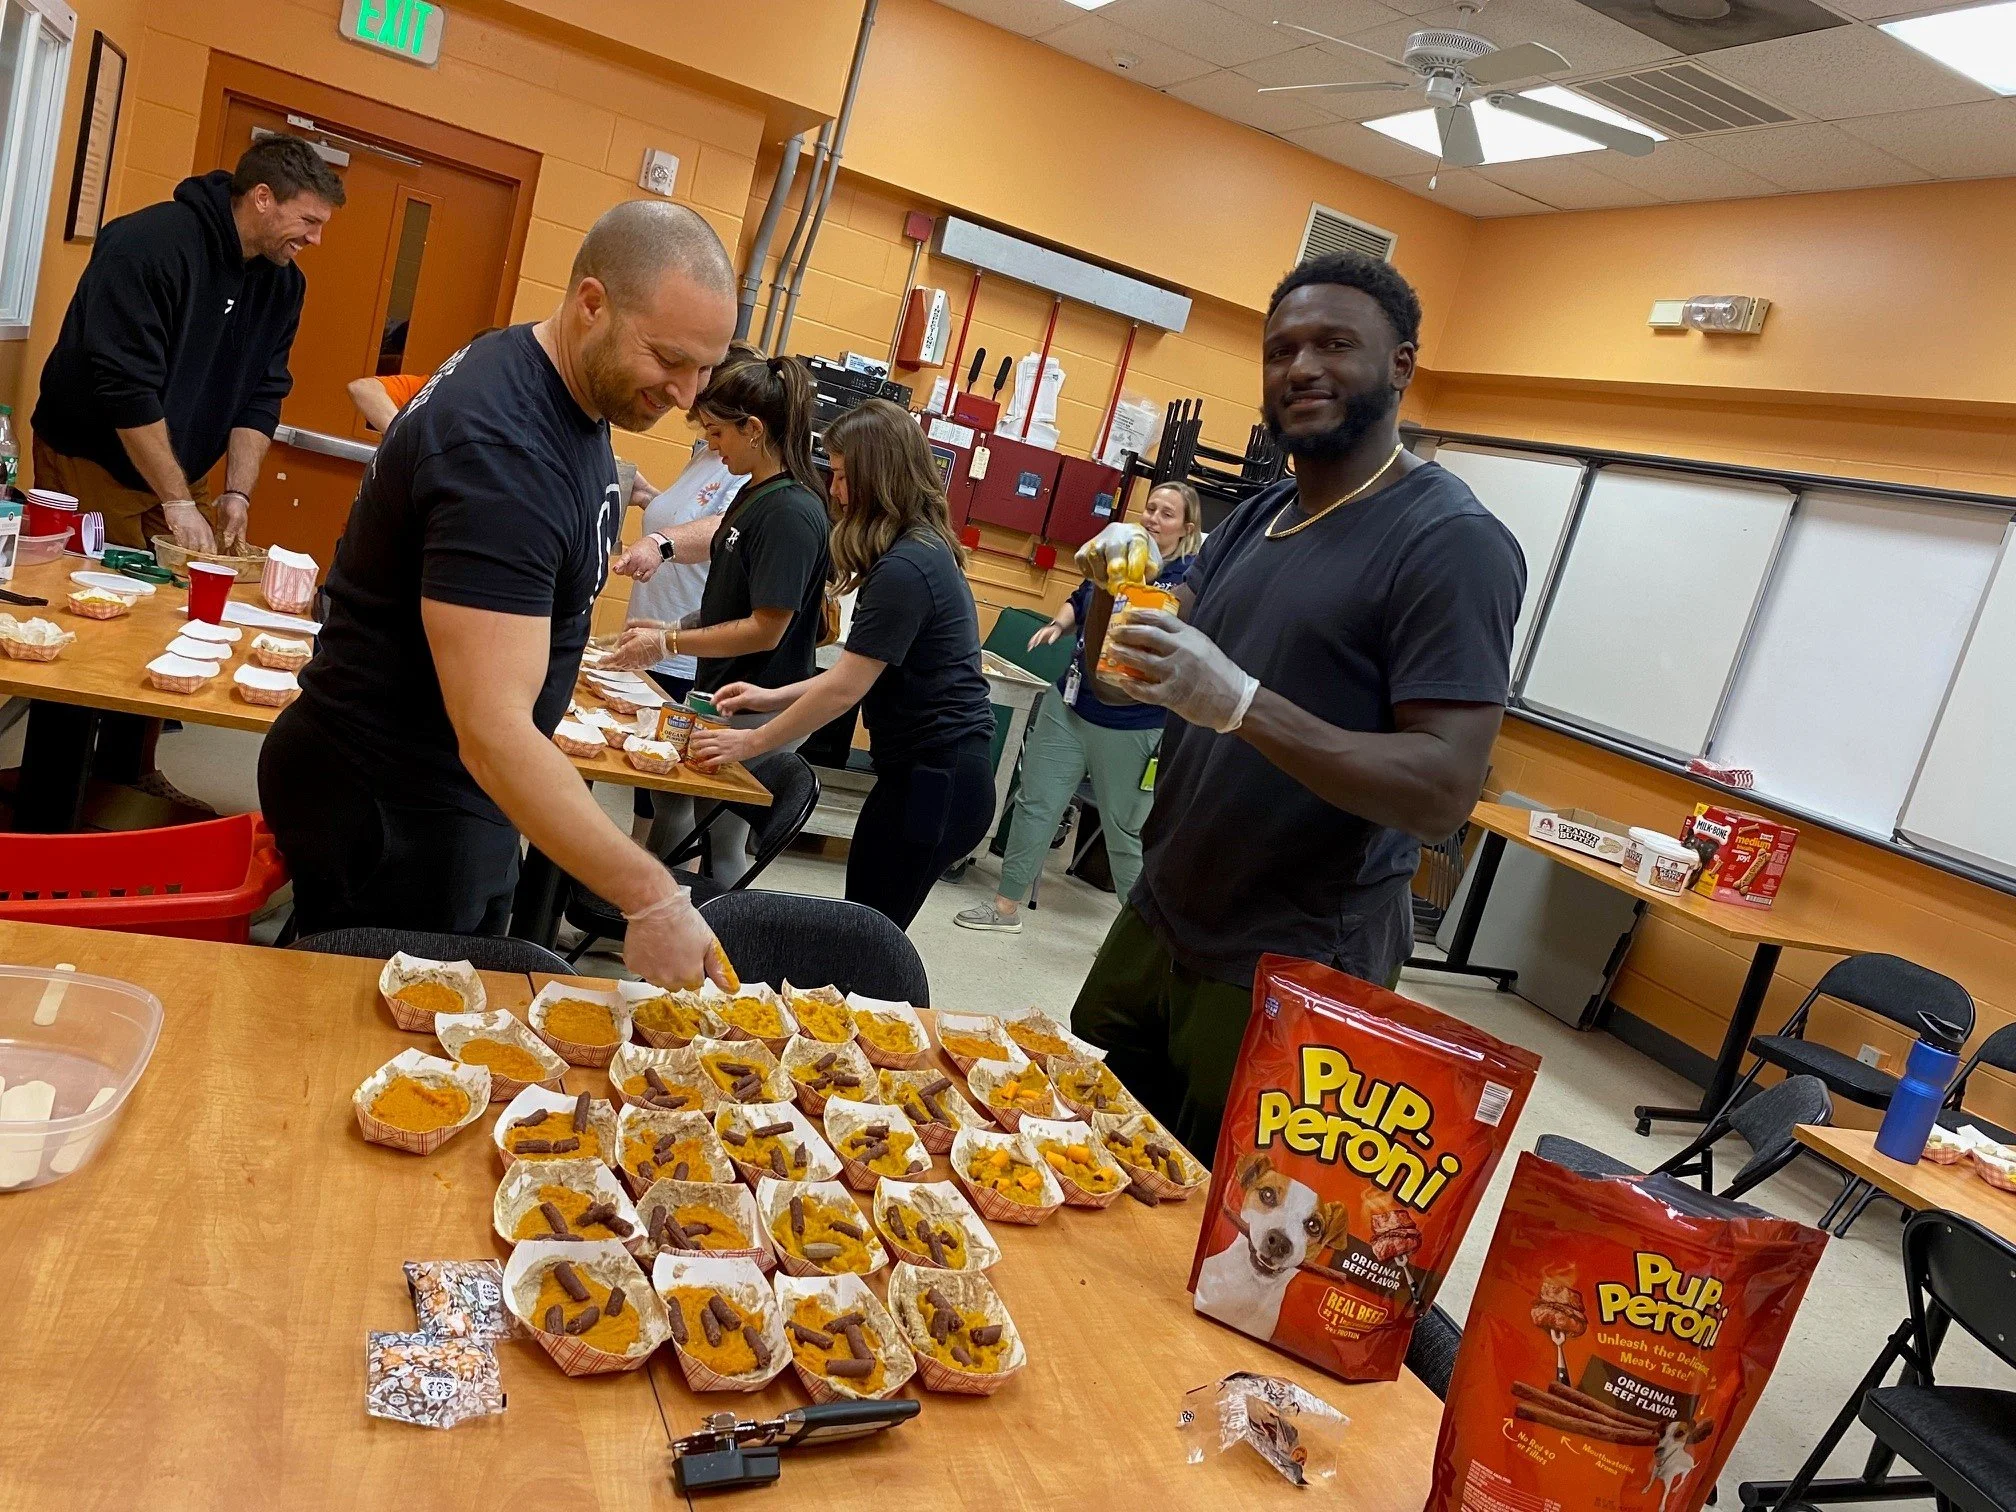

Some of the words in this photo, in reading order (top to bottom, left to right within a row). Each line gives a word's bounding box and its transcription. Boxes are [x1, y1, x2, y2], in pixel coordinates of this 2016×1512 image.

[357, 0, 434, 55] EXIT
[1559, 823, 1600, 844] PEANUT
[1559, 832, 1597, 849] BUTTER
[1735, 836, 1771, 850] medium
[1736, 854, 1751, 863] joy!
[1256, 1090, 1461, 1212] Peroni
[1342, 1259, 1368, 1277] BEEF
[1366, 1271, 1400, 1291] FLAVOR
[1351, 1252, 1402, 1280] ORIGINAL
[1326, 1292, 1356, 1319] REAL
[1356, 1304, 1384, 1325] BEEF
[1598, 1282, 1730, 1348] Peroni
[1597, 1332, 1648, 1352] Unleash
[1653, 1345, 1675, 1359] the
[1620, 1351, 1657, 1371] Meaty
[1603, 1381, 1635, 1402] BEEF
[1635, 1397, 1678, 1419] FLAVOR
[1617, 1376, 1675, 1406] ORIGINAL
[1517, 1431, 1529, 1442] No
[1529, 1438, 1544, 1452] Red
[1595, 1459, 1618, 1476] Aroma
